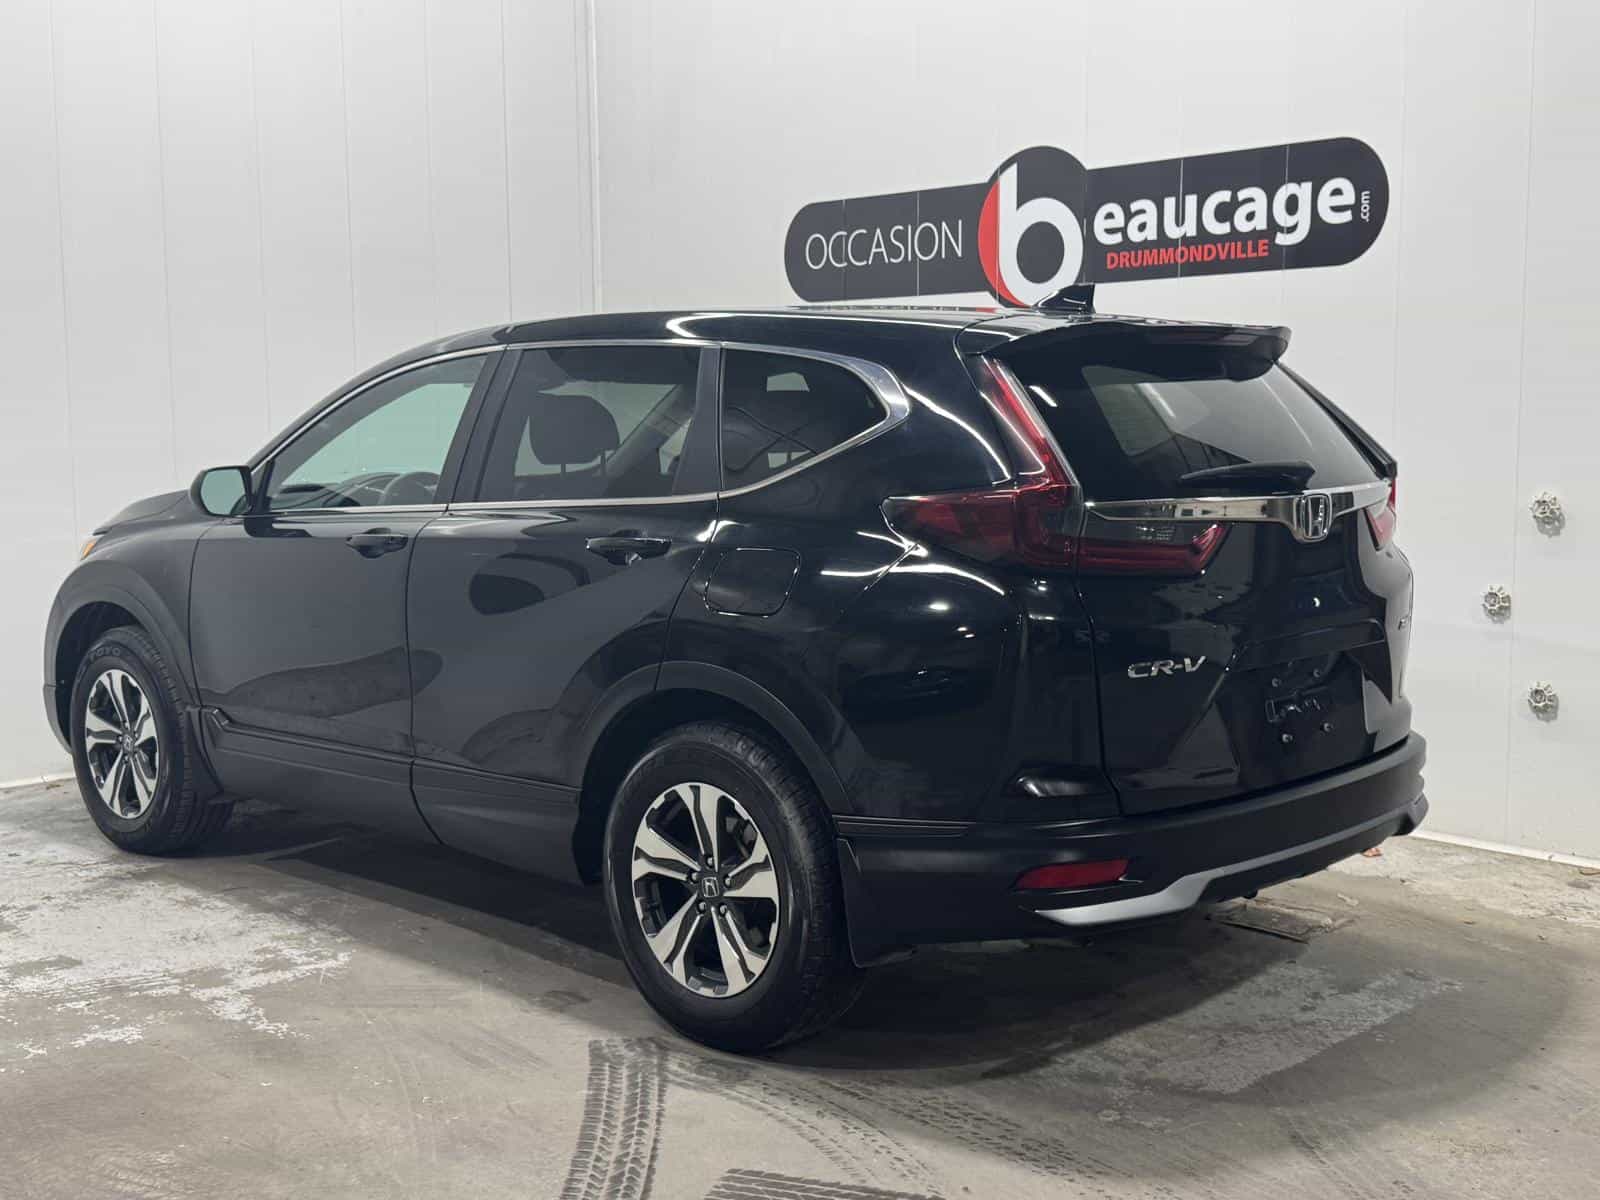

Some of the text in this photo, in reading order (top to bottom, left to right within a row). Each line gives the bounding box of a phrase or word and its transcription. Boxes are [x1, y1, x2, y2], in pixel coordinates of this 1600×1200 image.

[1360, 190, 1371, 222] .com
[805, 219, 964, 270] OCCASION
[1106, 239, 1269, 270] DRUMMONDVILLE
[1127, 655, 1206, 679] CR-V
